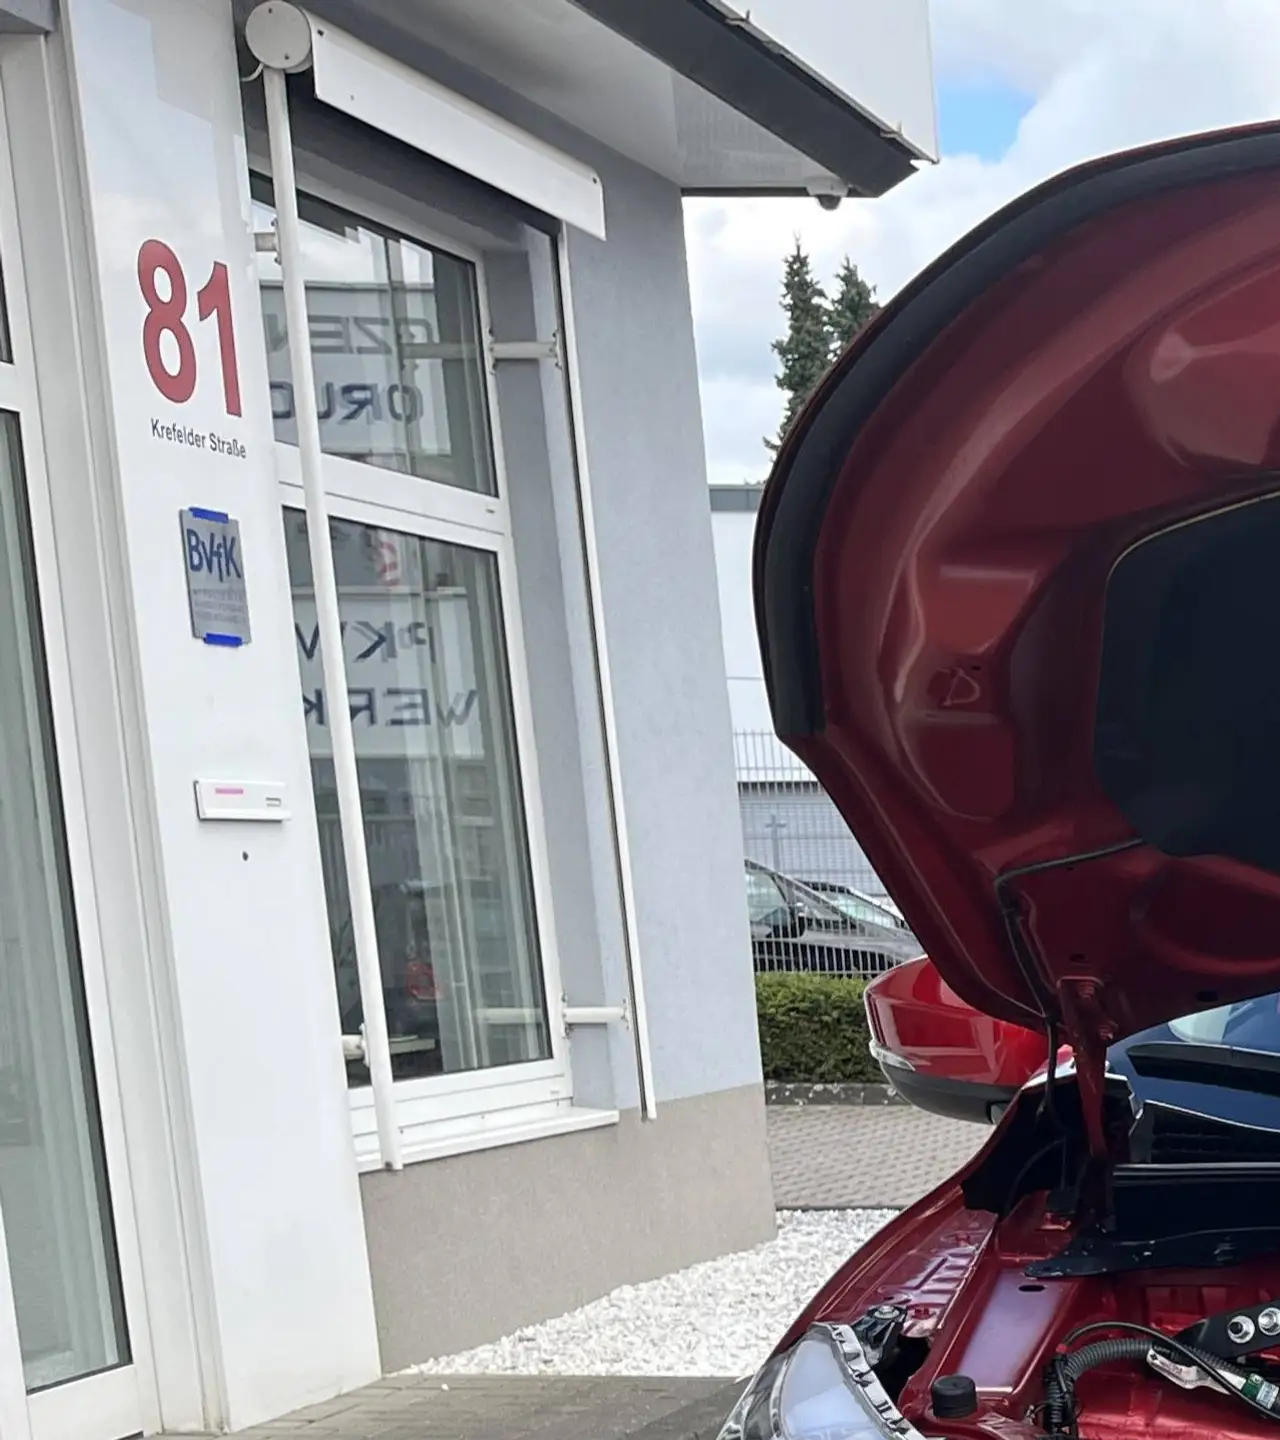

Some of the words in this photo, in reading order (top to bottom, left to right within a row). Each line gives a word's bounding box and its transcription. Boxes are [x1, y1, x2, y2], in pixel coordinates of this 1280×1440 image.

[137, 238, 242, 419] 81
[150, 418, 207, 449] Krefelder
[209, 432, 248, 459] Straße
[187, 528, 242, 582] BVfK
